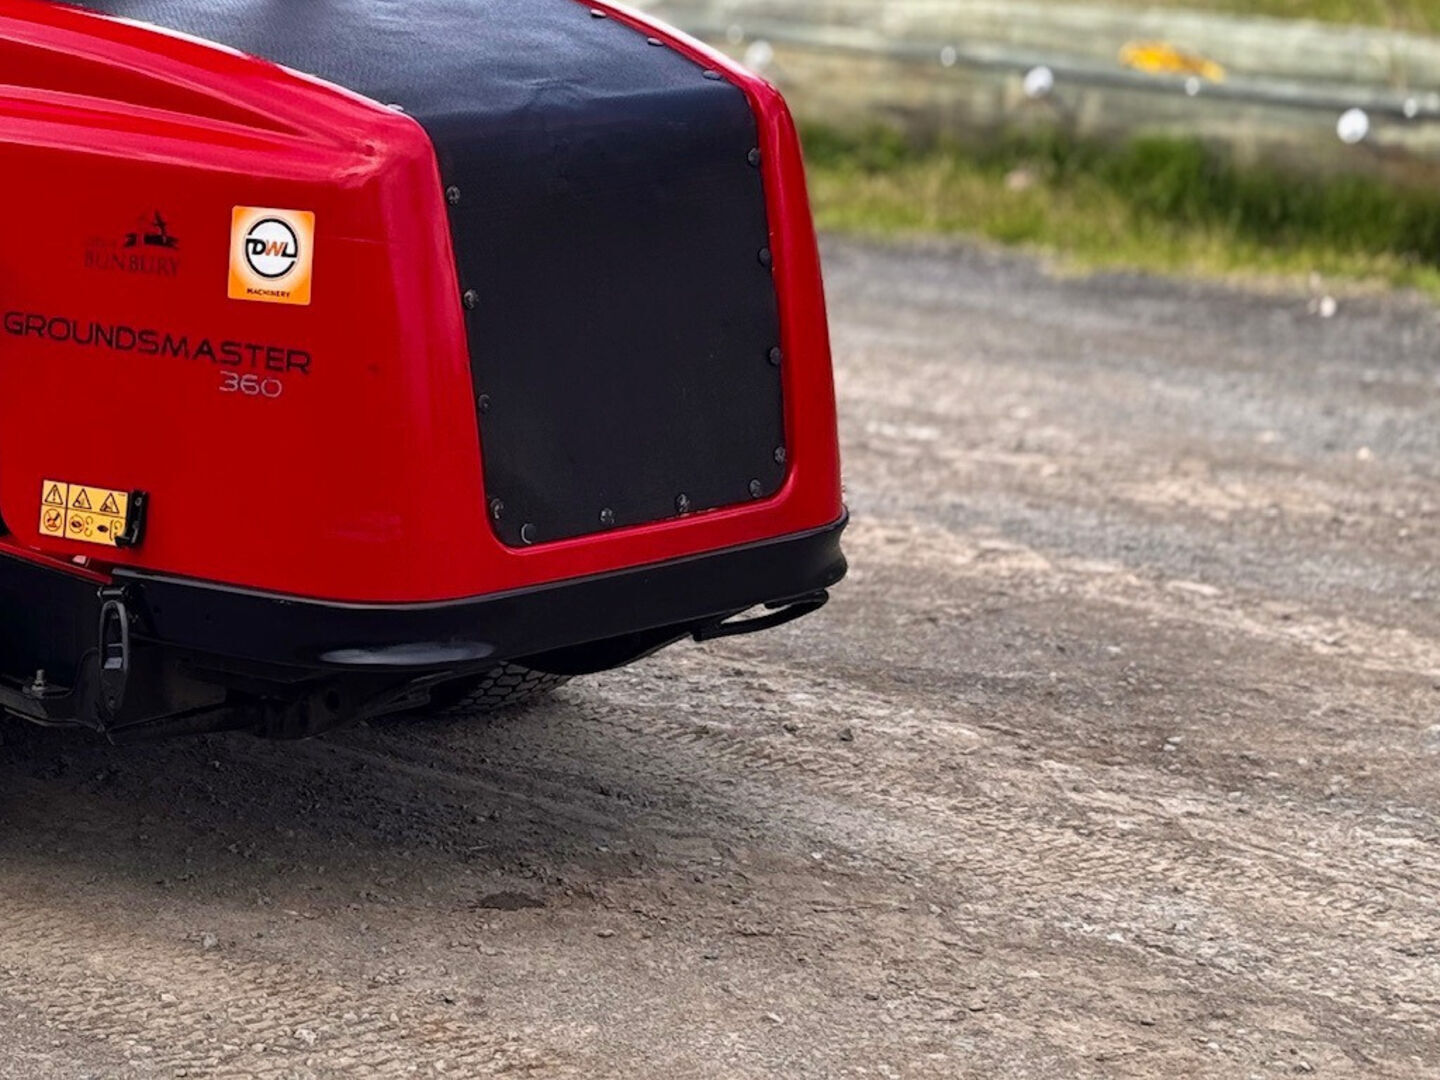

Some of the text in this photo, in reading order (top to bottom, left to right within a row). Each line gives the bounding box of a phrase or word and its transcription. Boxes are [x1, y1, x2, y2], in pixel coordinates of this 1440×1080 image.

[246, 287, 291, 298] MACHINERY
[4, 311, 312, 374] GROUNDSMASTER
[219, 371, 282, 398] 360
